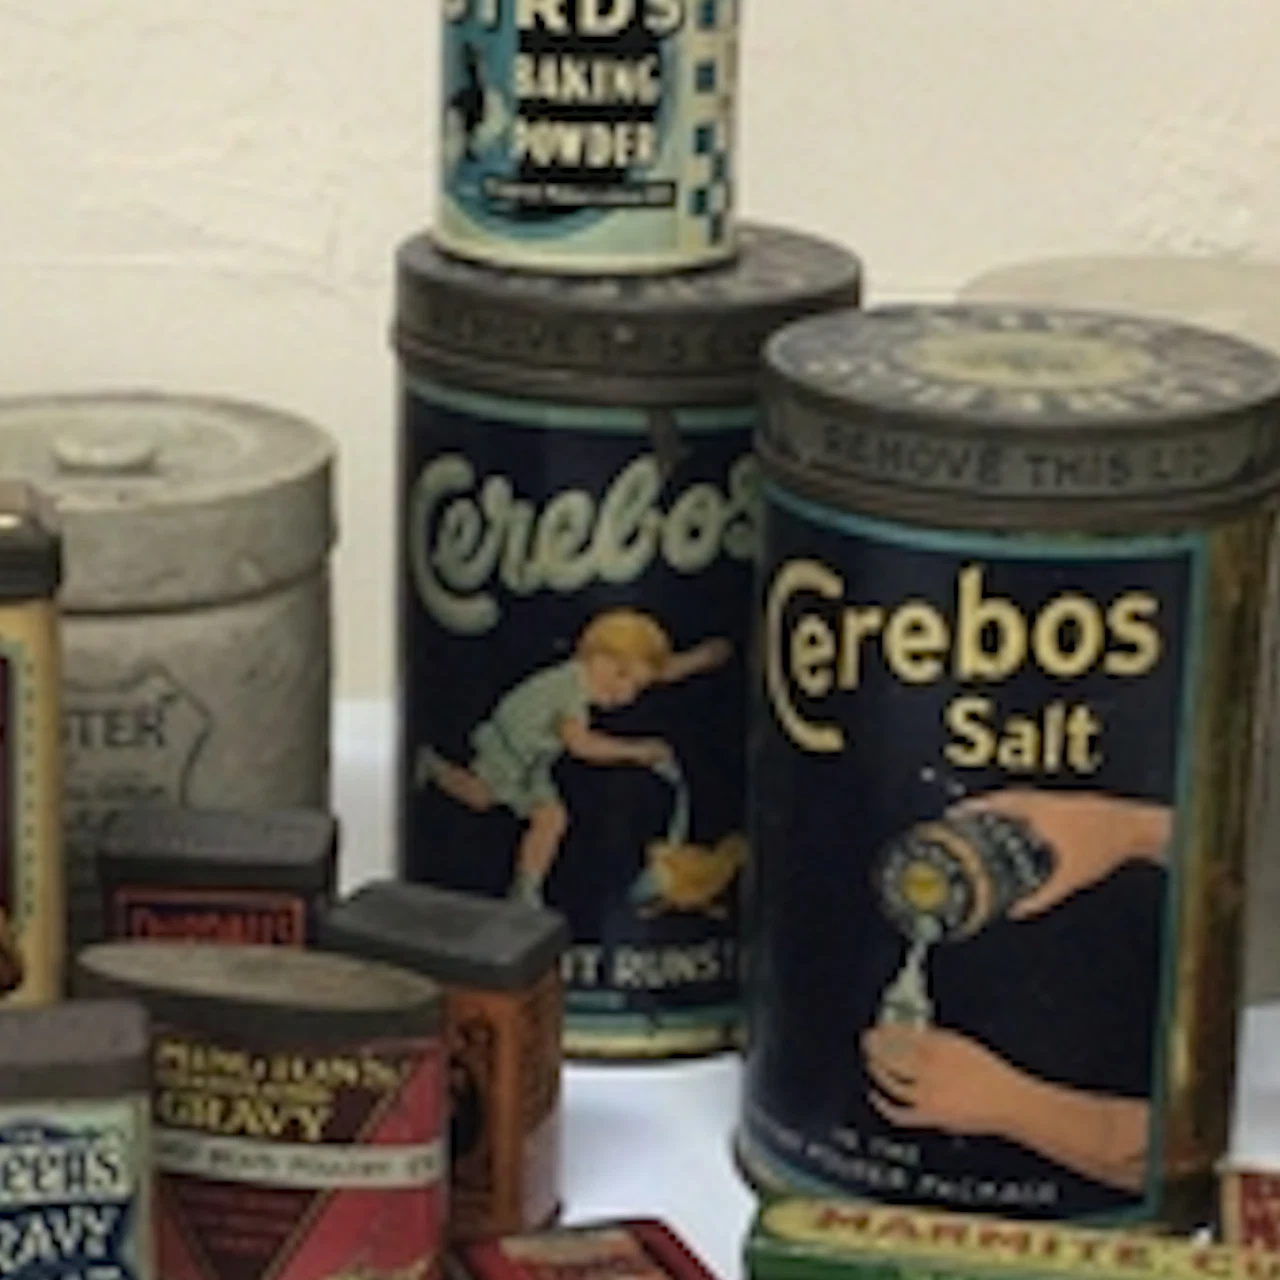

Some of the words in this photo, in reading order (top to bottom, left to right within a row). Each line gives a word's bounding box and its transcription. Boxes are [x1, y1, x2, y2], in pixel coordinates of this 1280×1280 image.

[514, 50, 661, 108] BAKING
[512, 114, 656, 168] POWDER
[765, 558, 1162, 754] Cerebos
[58, 704, 168, 750] TER
[945, 697, 1103, 774] Salt
[818, 1204, 1153, 1276] MARMITE
